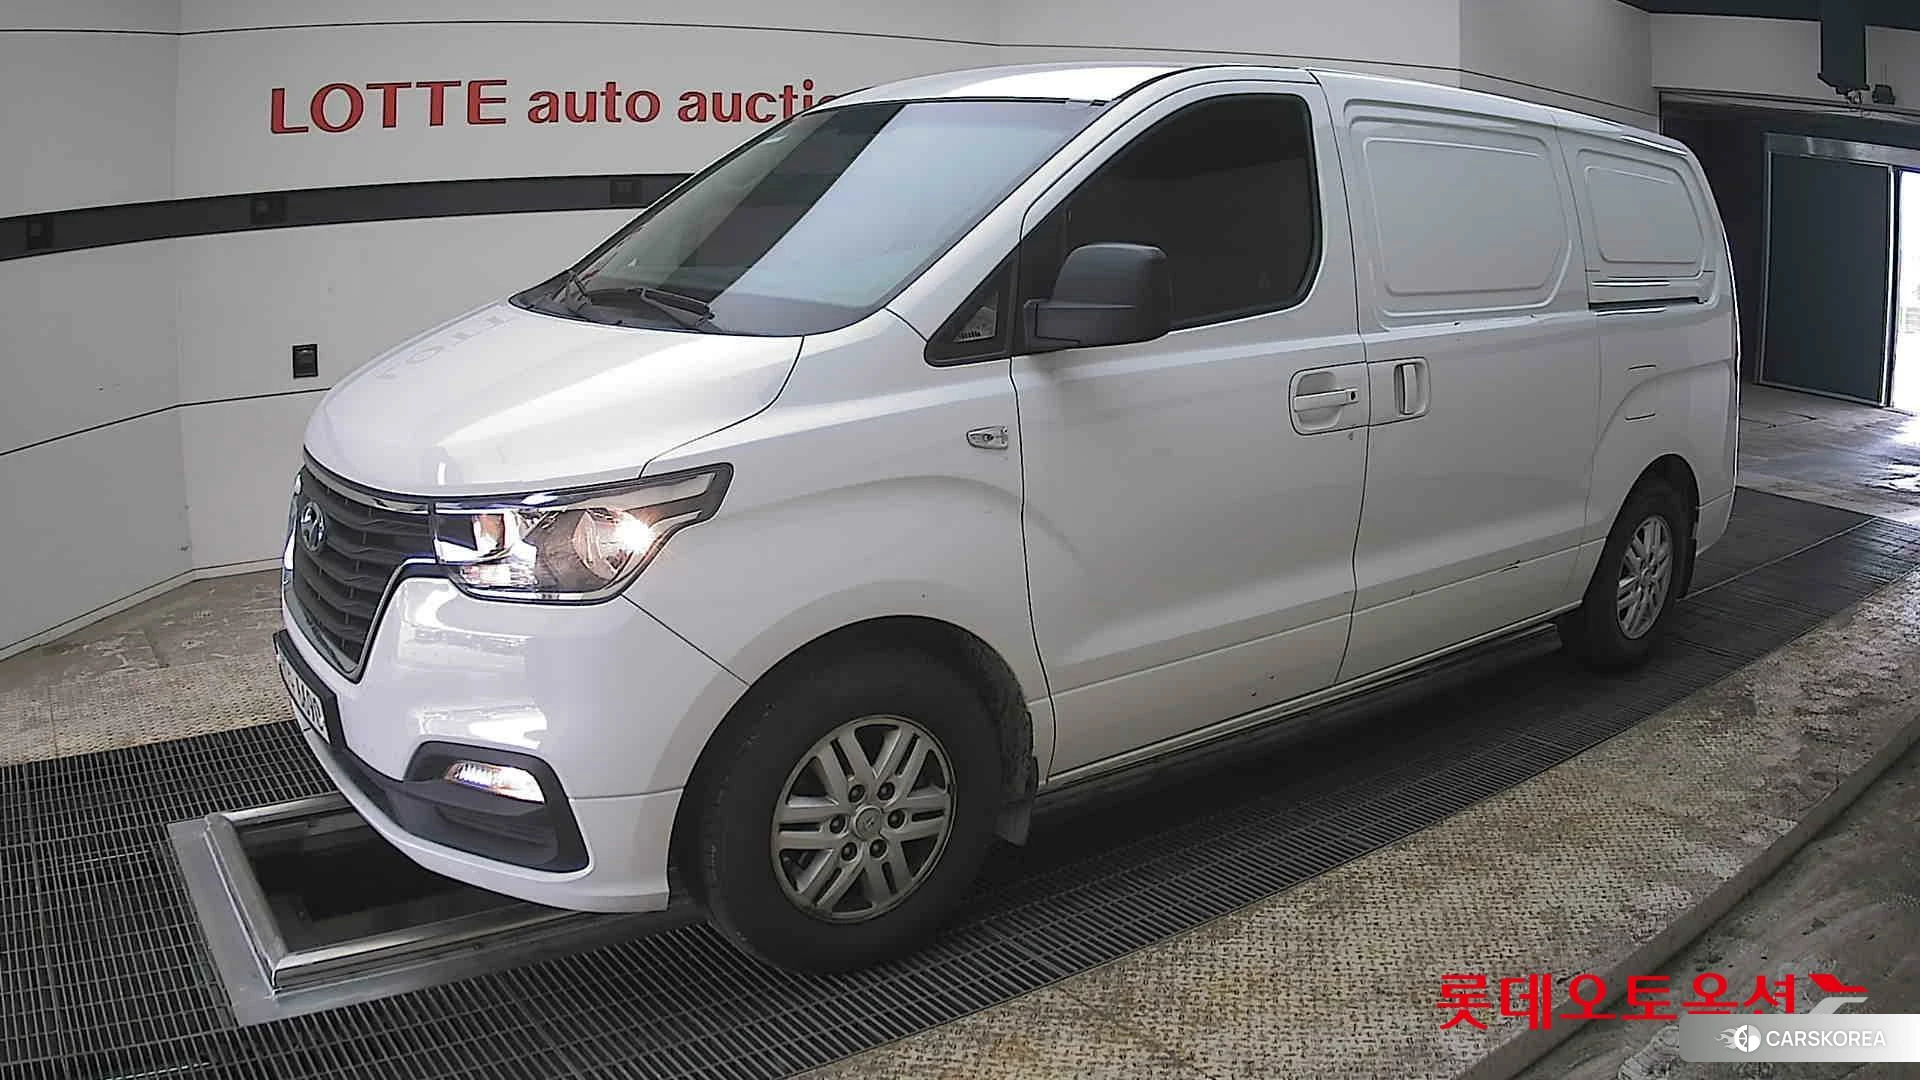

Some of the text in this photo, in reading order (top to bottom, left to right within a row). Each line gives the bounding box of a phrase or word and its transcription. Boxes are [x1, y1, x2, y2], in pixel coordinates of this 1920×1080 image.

[270, 79, 838, 134] LOTTE auto aucti
